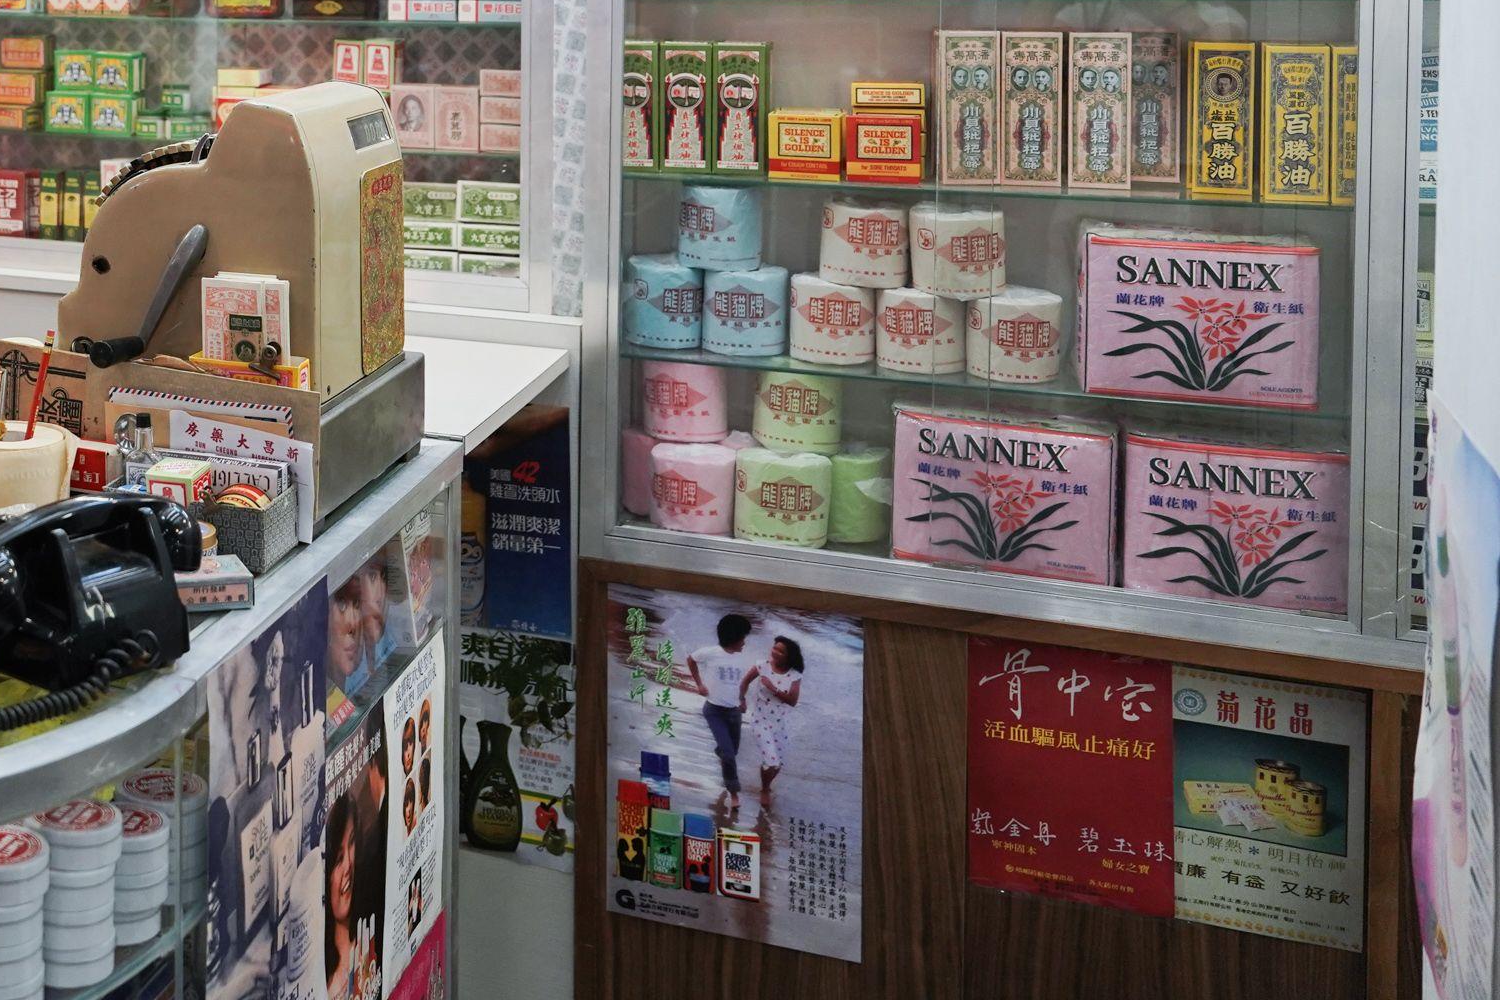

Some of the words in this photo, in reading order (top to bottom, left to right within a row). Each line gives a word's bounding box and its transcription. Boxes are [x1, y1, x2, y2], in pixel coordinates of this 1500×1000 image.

[784, 128, 825, 137] SILENCE
[799, 136, 809, 144] IS
[863, 129, 906, 139] SILENCE
[784, 144, 825, 153] GOLDEN
[863, 145, 906, 155] GOLDEN
[879, 138, 890, 146] IS
[1280, 112, 1315, 185] 百勝油
[1208, 121, 1238, 181] 百勝油
[869, 163, 882, 171] SORE
[1116, 254, 1287, 293] SANNEX
[1116, 293, 1164, 308] 蘭花牌
[185, 422, 299, 463] 新昌大藥房
[195, 441, 206, 449] SUN
[215, 446, 238, 456] CHEONG
[918, 428, 1070, 474] SANNEX
[918, 463, 961, 480] 蘭花牌
[1149, 456, 1318, 501] SANNEX
[1149, 495, 1198, 512] 蘭花牌
[492, 512, 561, 536] 滋潤爽潔
[492, 533, 562, 554] 銷量第一
[1216, 690, 1313, 737] 菊花晶
[983, 718, 1156, 761] 活血驅風止痛好
